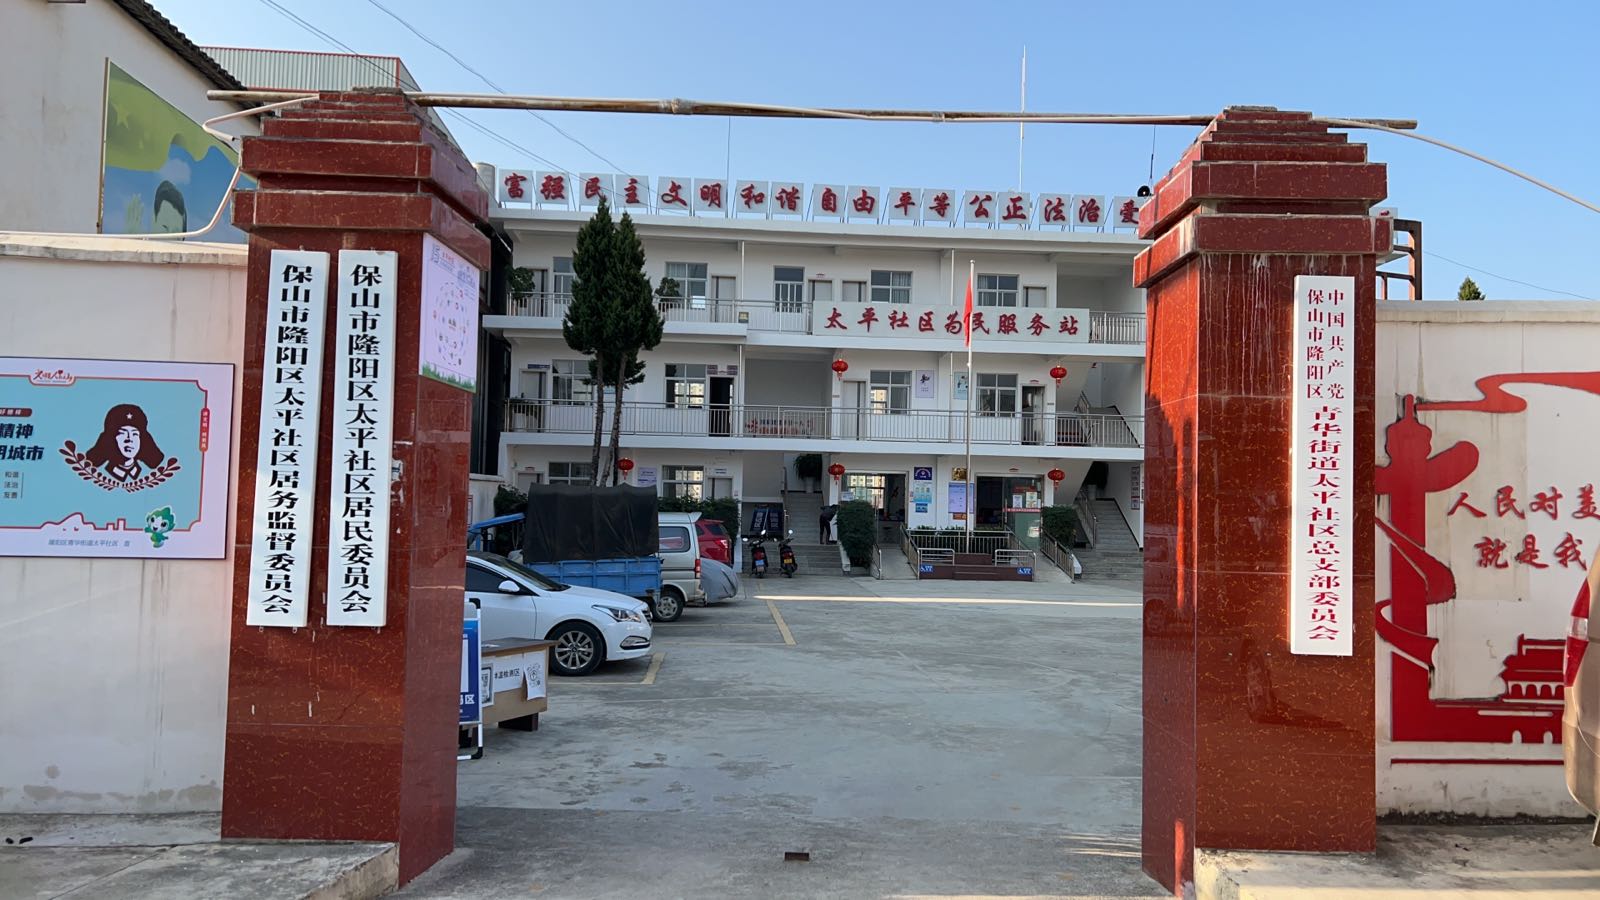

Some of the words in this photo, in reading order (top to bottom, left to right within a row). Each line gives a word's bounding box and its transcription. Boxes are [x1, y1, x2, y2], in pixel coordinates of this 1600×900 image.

[824, 306, 1079, 336] 太平社区为民服务站
[1306, 288, 1325, 399] 保山市隆阳区
[1327, 289, 1345, 399] 中国共产党
[261, 264, 313, 613] 保山市隆阳区太平社区居务监督委员会
[340, 264, 383, 613] 保山市隆阳区太平社区居民委员会
[1307, 405, 1342, 641] 青华街道太平社区总支部委员会
[1447, 483, 1600, 520] 人民对美
[1474, 531, 1587, 571] 就是我
